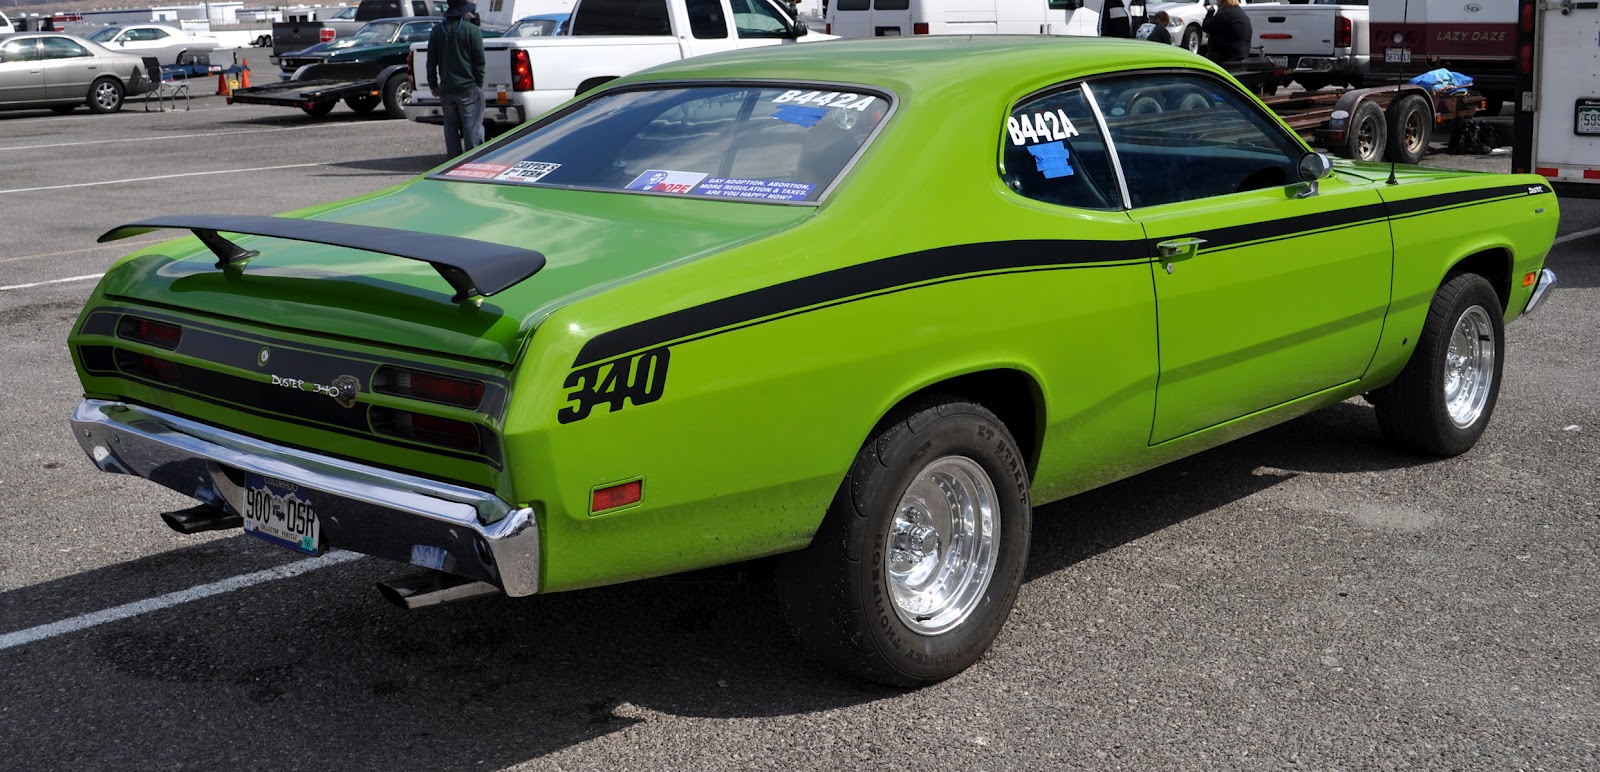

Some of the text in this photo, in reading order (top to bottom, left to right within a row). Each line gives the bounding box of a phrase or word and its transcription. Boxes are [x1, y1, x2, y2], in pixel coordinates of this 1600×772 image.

[1437, 31, 1507, 41] LAZY DAZE
[771, 90, 877, 112] B442A
[1007, 109, 1080, 146] B442A
[723, 185, 772, 193] REGULATION
[739, 191, 767, 199] HAPPY
[767, 193, 793, 201] NOW?
[271, 374, 340, 398] DUSTER 340
[558, 346, 671, 425] 340
[246, 488, 316, 539] 900 DSR
[304, 538, 312, 548] 16
